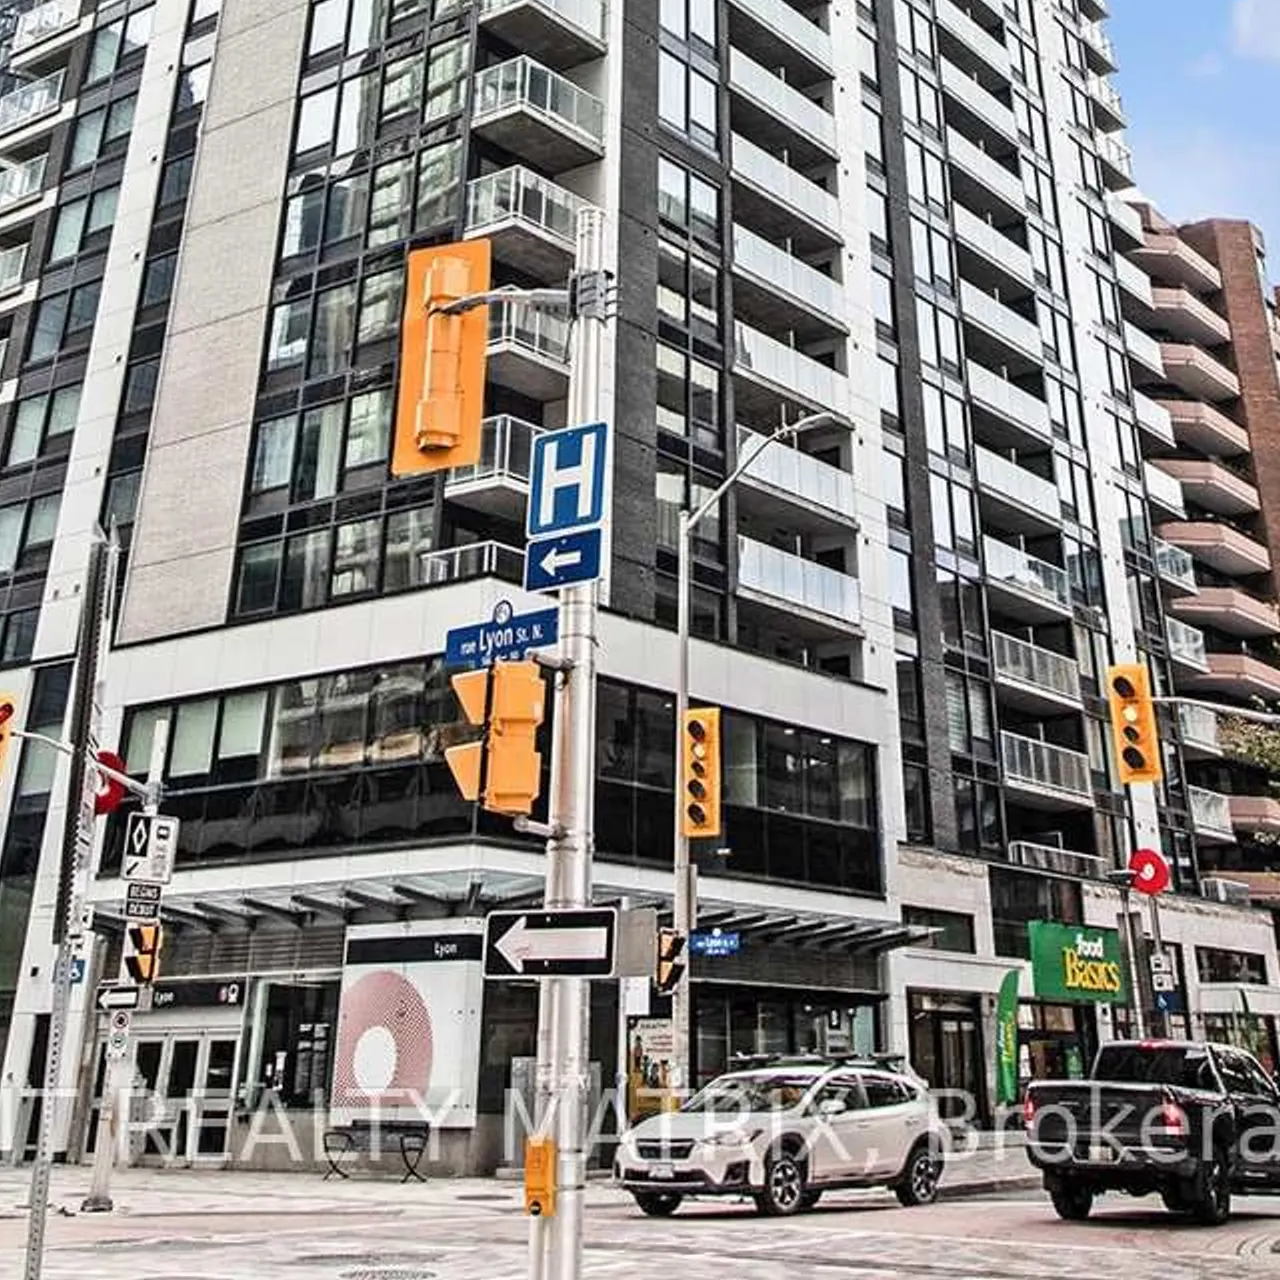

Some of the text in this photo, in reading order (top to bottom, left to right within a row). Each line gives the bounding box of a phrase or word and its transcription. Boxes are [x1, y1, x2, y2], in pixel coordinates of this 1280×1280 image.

[539, 432, 596, 527] H
[480, 628, 513, 656] Lyon
[434, 941, 457, 958] Lyon
[1075, 932, 1104, 958] food
[1063, 946, 1120, 992] Basics
